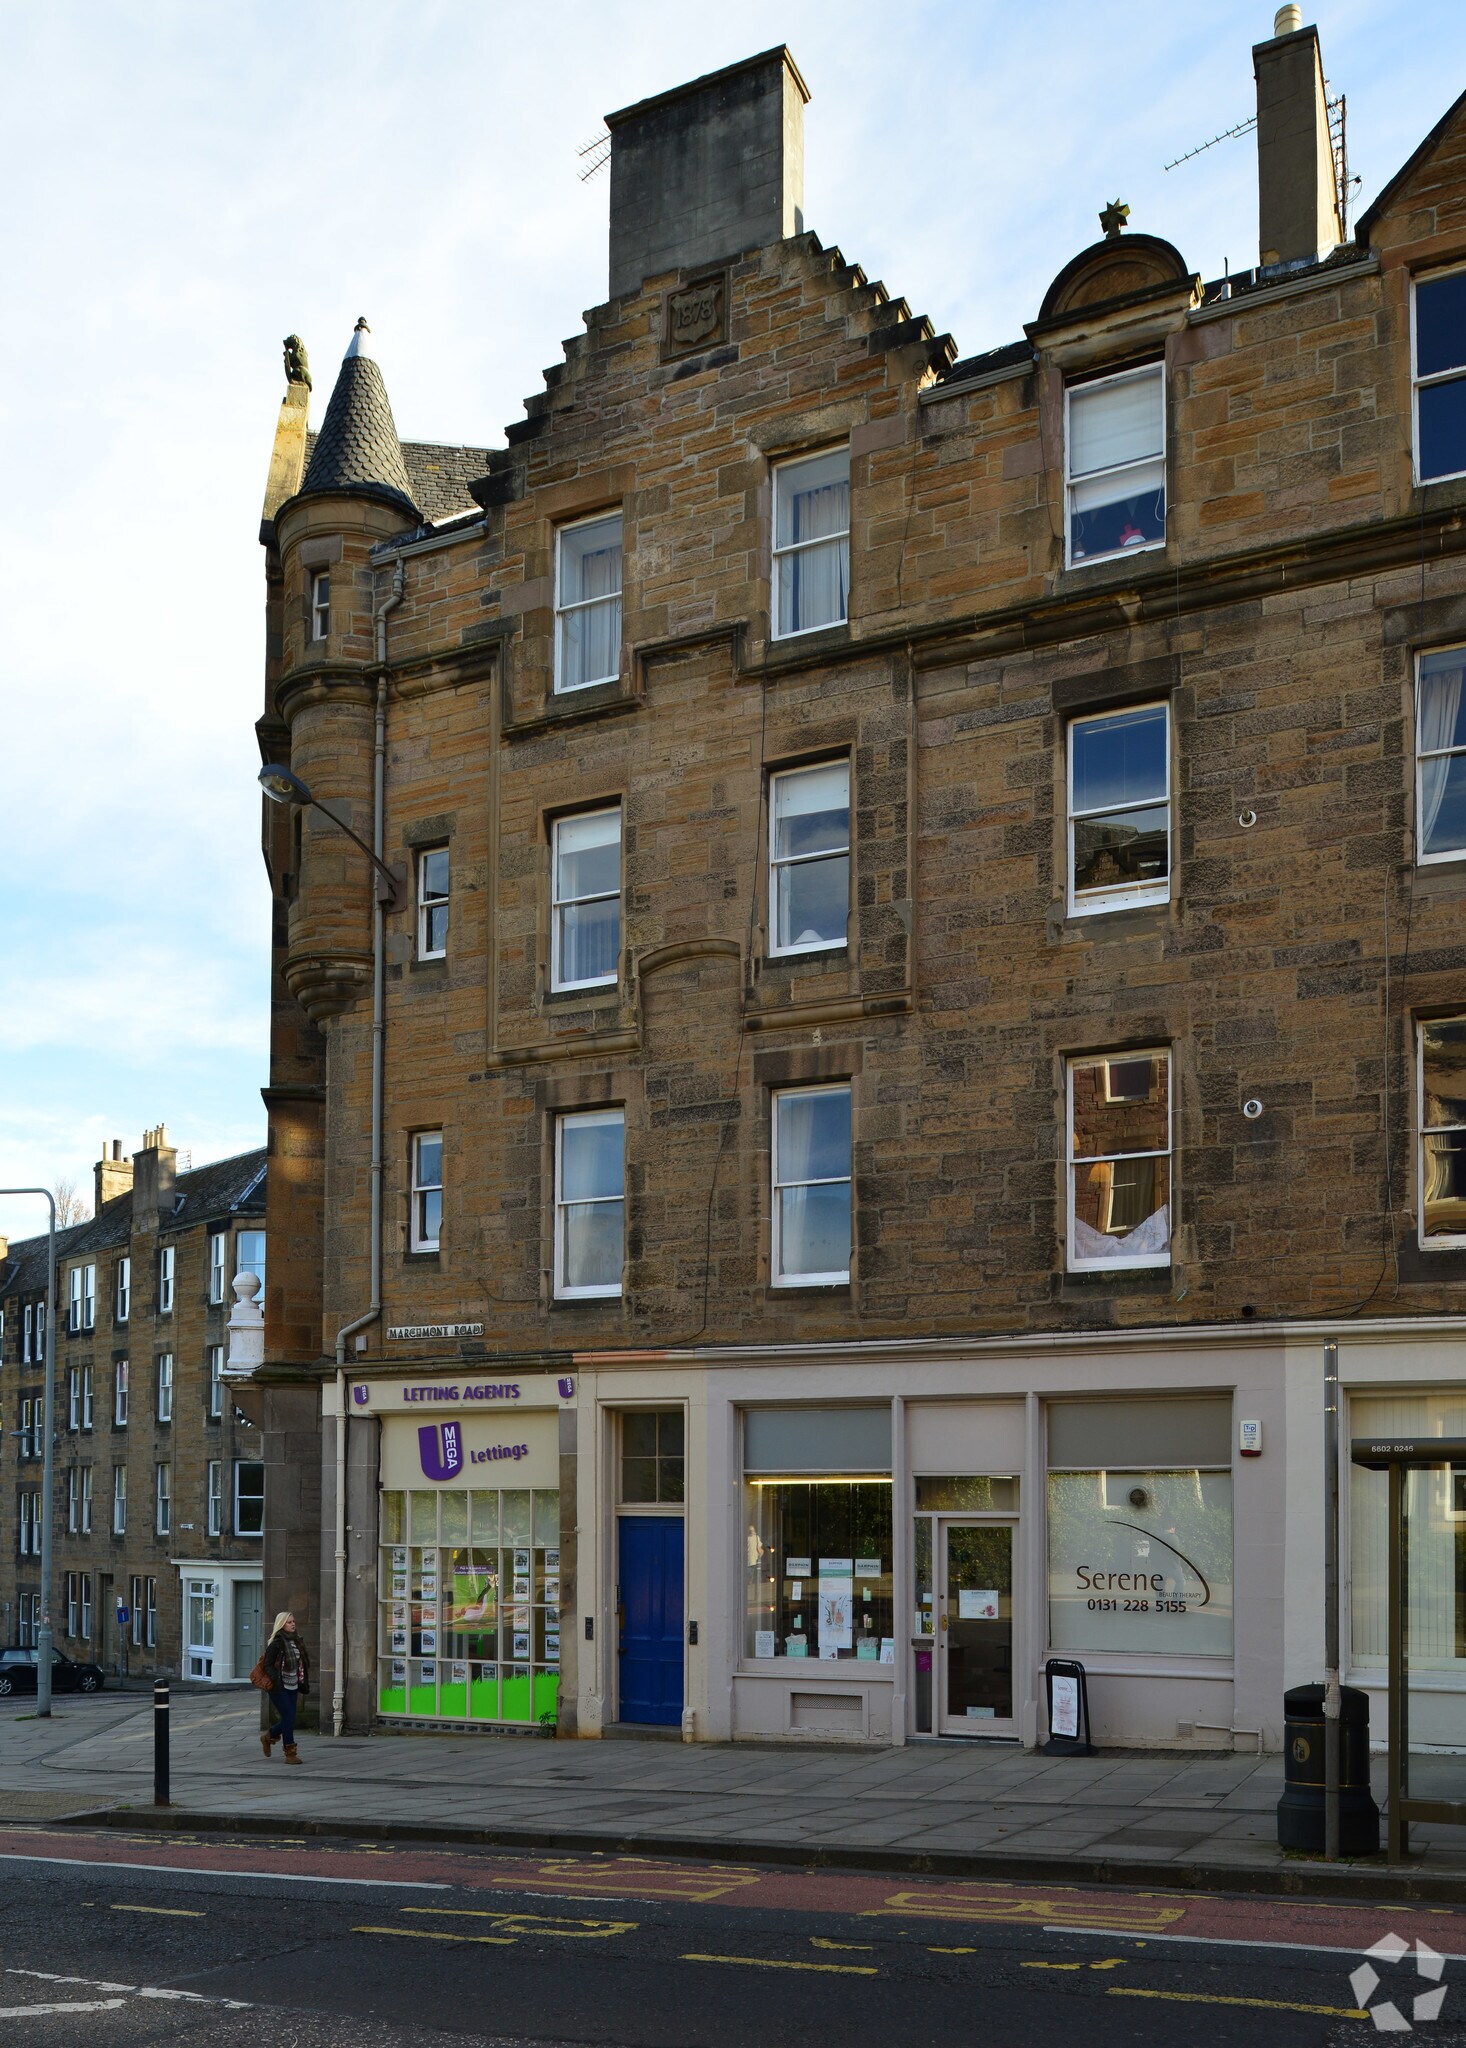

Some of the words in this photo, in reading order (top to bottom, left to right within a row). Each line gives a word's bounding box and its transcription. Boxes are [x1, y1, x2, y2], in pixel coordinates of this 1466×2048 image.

[676, 298, 714, 329] 1878
[389, 1326, 449, 1339] MARCHMONT
[454, 1325, 481, 1335] ROAD
[403, 1386, 459, 1402] LETTING
[462, 1384, 521, 1401] AGENTS
[444, 1425, 459, 1470] MEGA
[470, 1442, 529, 1465] Lettings
[1371, 1445, 1391, 1453] 6602
[1076, 1565, 1164, 1592] Serene
[1087, 1598, 1117, 1611] 0131
[1123, 1599, 1149, 1612] 228
[1155, 1600, 1187, 1613] 5155
